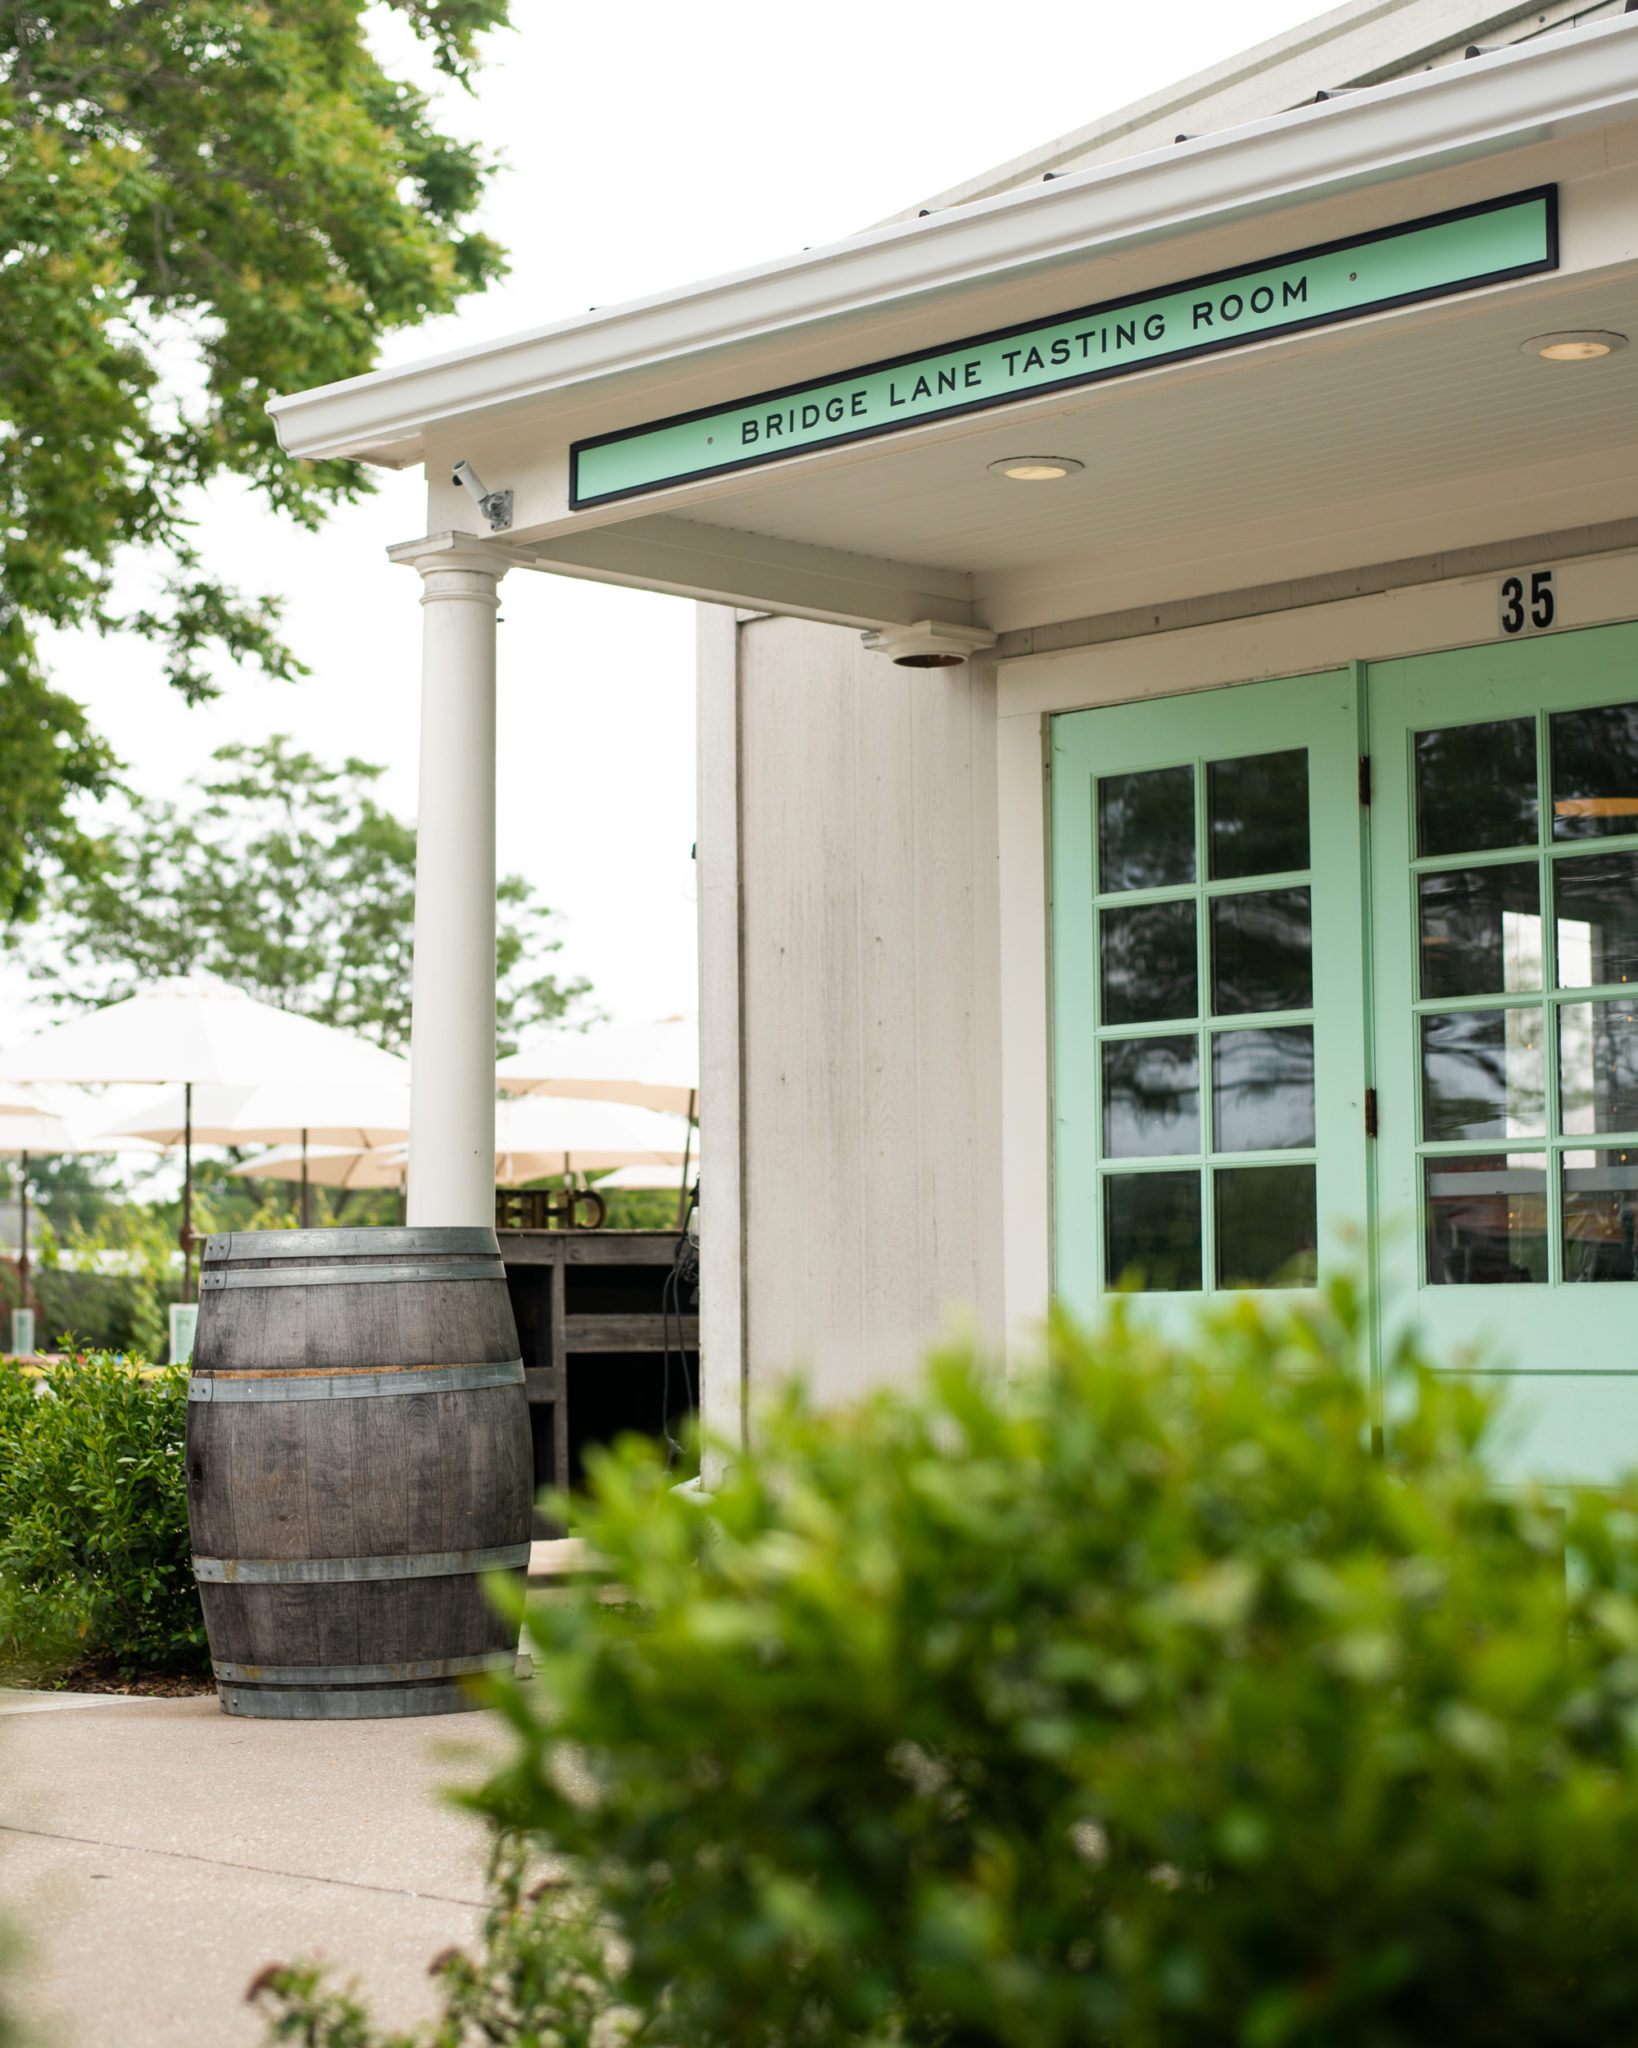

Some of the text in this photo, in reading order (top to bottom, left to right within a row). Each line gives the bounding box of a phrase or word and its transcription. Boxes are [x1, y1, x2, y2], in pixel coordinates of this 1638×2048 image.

[741, 275, 1308, 445] BRIDGE LANE TASTING ROOM
[1501, 570, 1555, 634] 35
